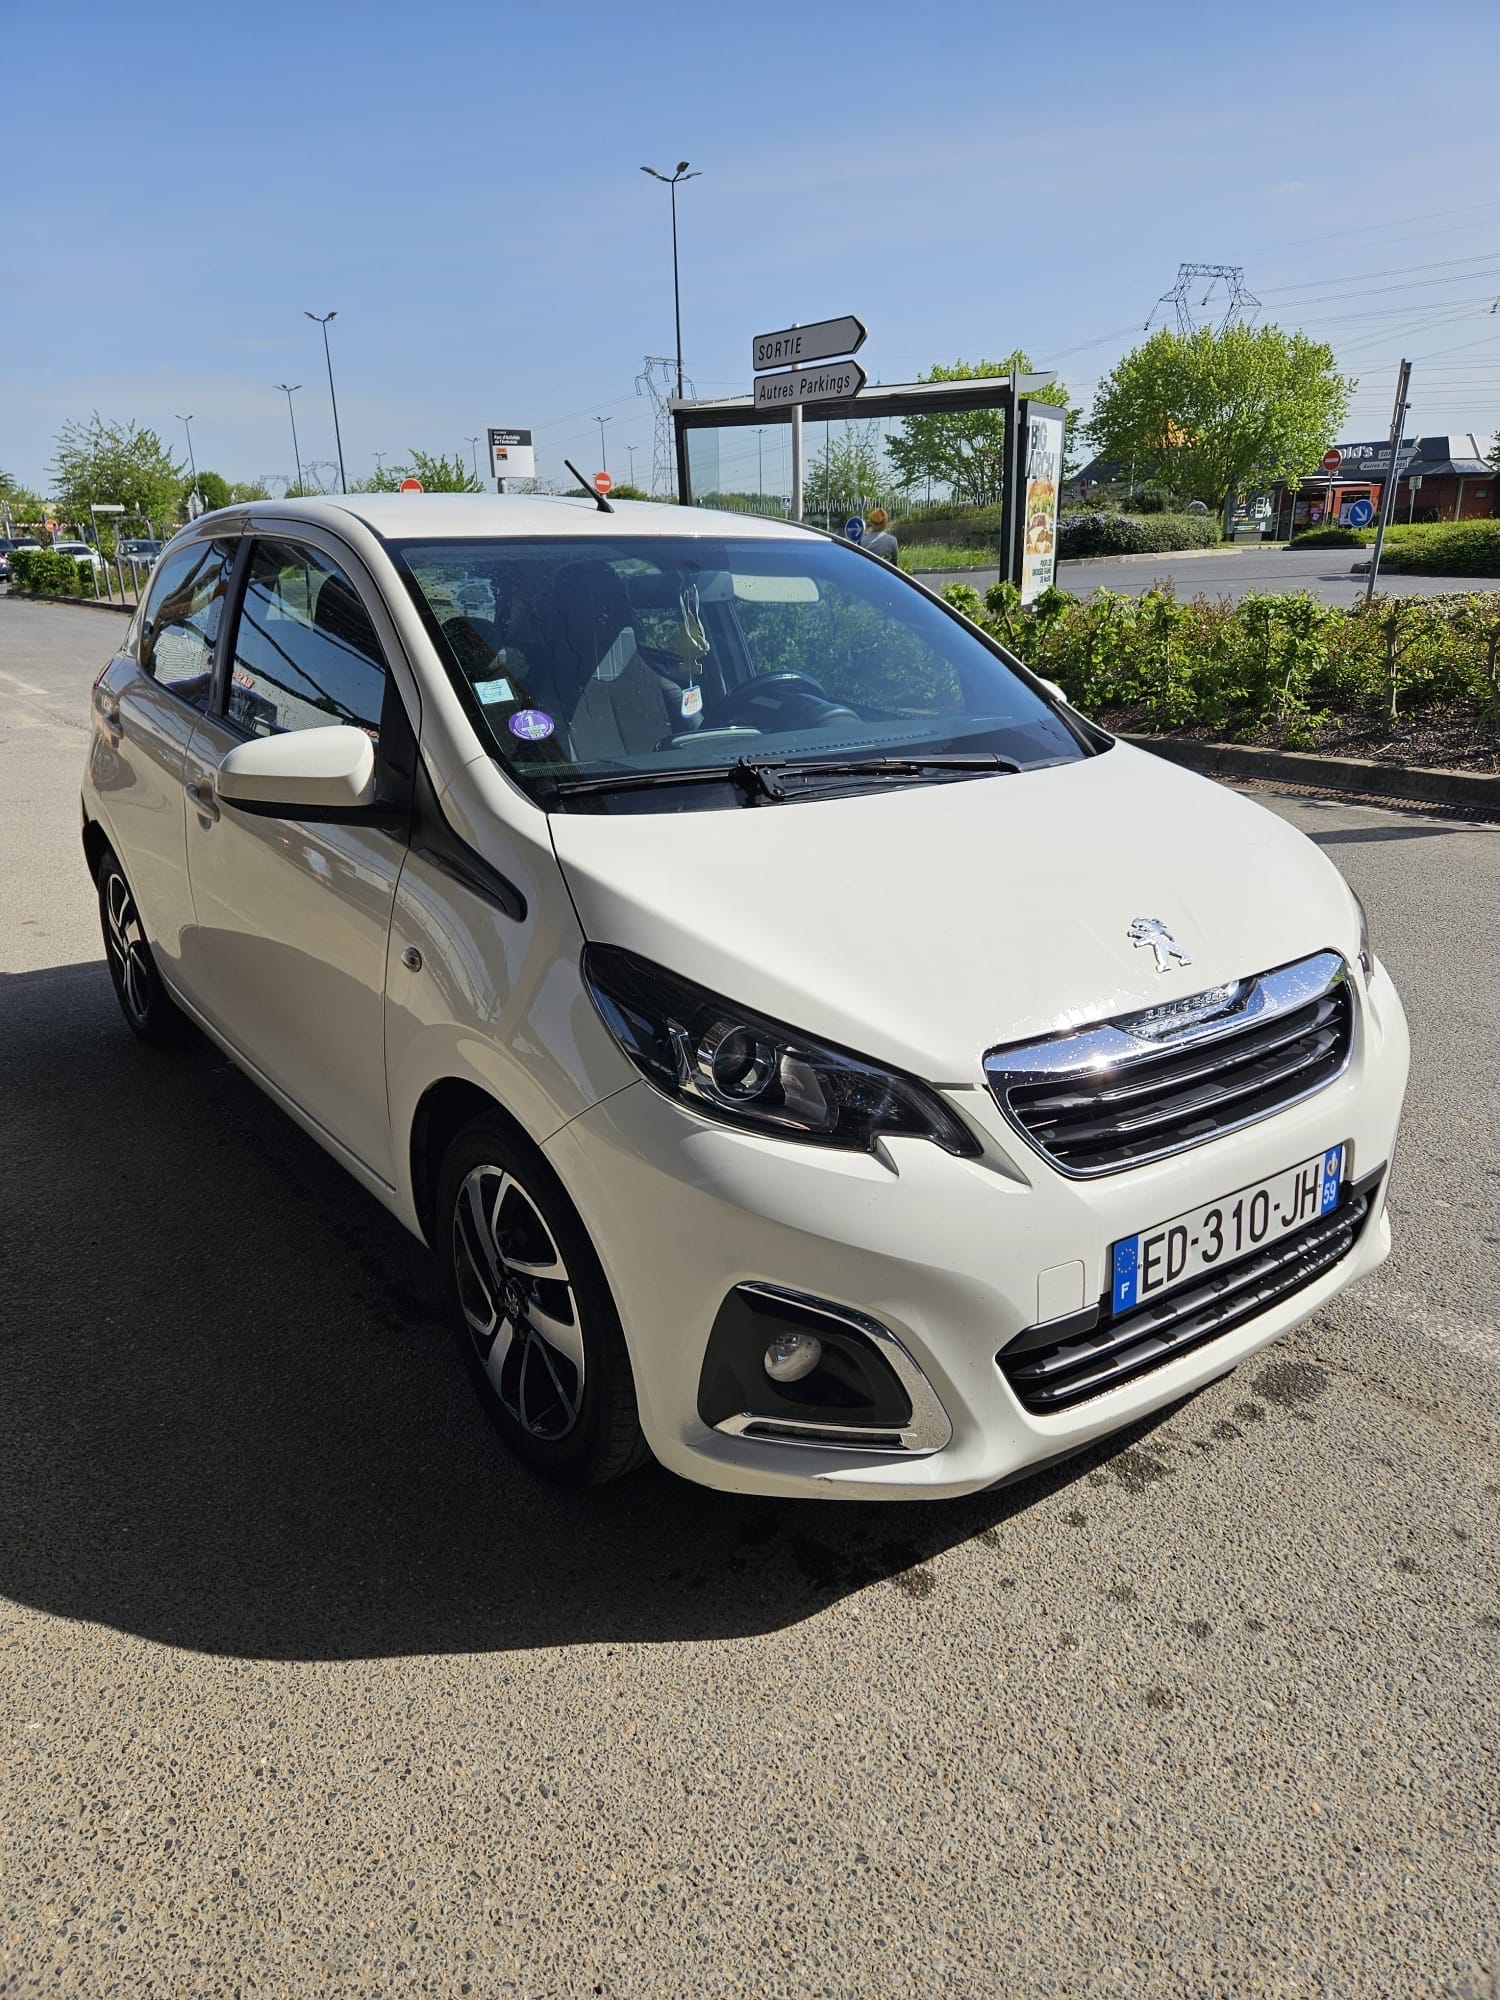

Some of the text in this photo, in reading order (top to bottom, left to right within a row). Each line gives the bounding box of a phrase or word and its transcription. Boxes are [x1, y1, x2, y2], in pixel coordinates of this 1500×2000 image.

[758, 336, 802, 361] SORTIE
[759, 374, 850, 401] Autres Parkings
[1031, 420, 1048, 452] BIG
[1322, 1180, 1336, 1205] 59
[1142, 1164, 1320, 1294] ED-310-JH
[1120, 1281, 1129, 1300] F
